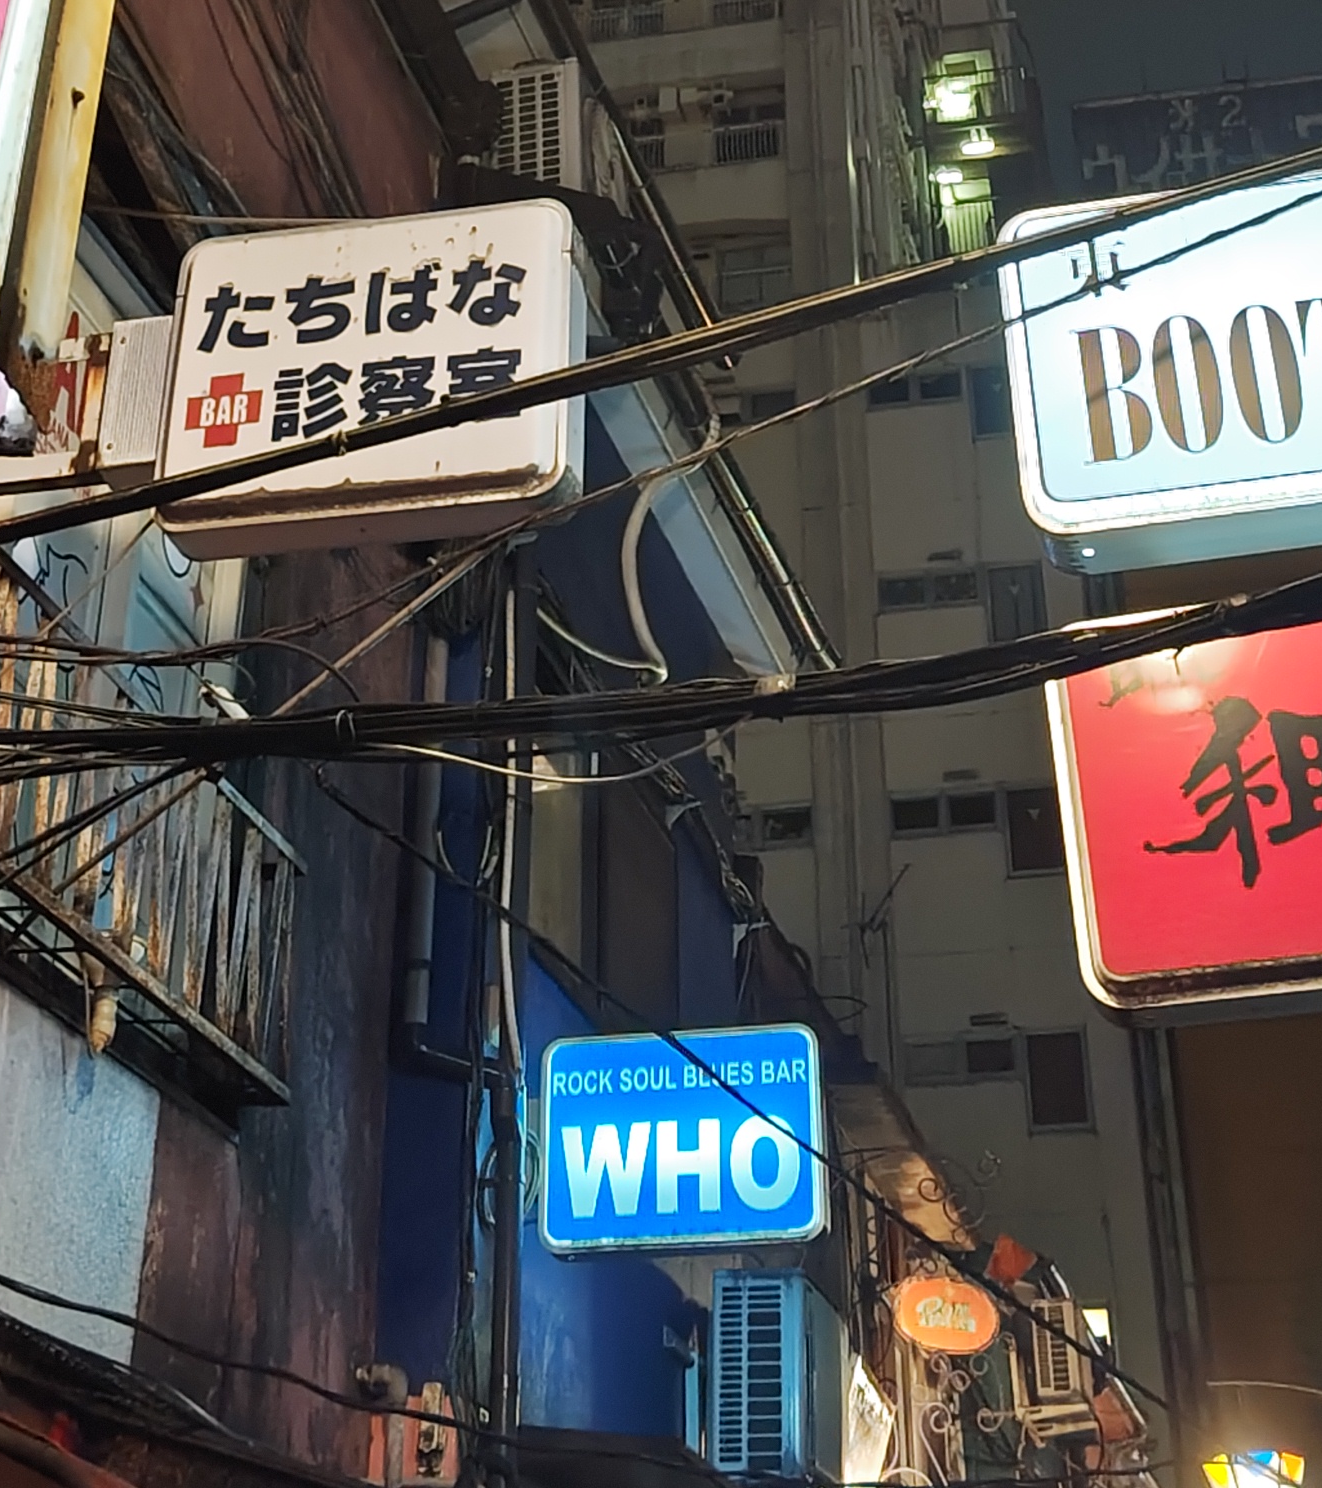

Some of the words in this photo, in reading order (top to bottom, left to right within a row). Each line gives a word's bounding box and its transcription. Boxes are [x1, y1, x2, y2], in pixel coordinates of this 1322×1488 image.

[197, 259, 527, 353] たちばな
[199, 393, 249, 427] BAR
[552, 1069, 614, 1097] ROCK
[619, 1064, 677, 1092] SOUL
[760, 1058, 807, 1085] BAR
[561, 1114, 801, 1220] WHO
